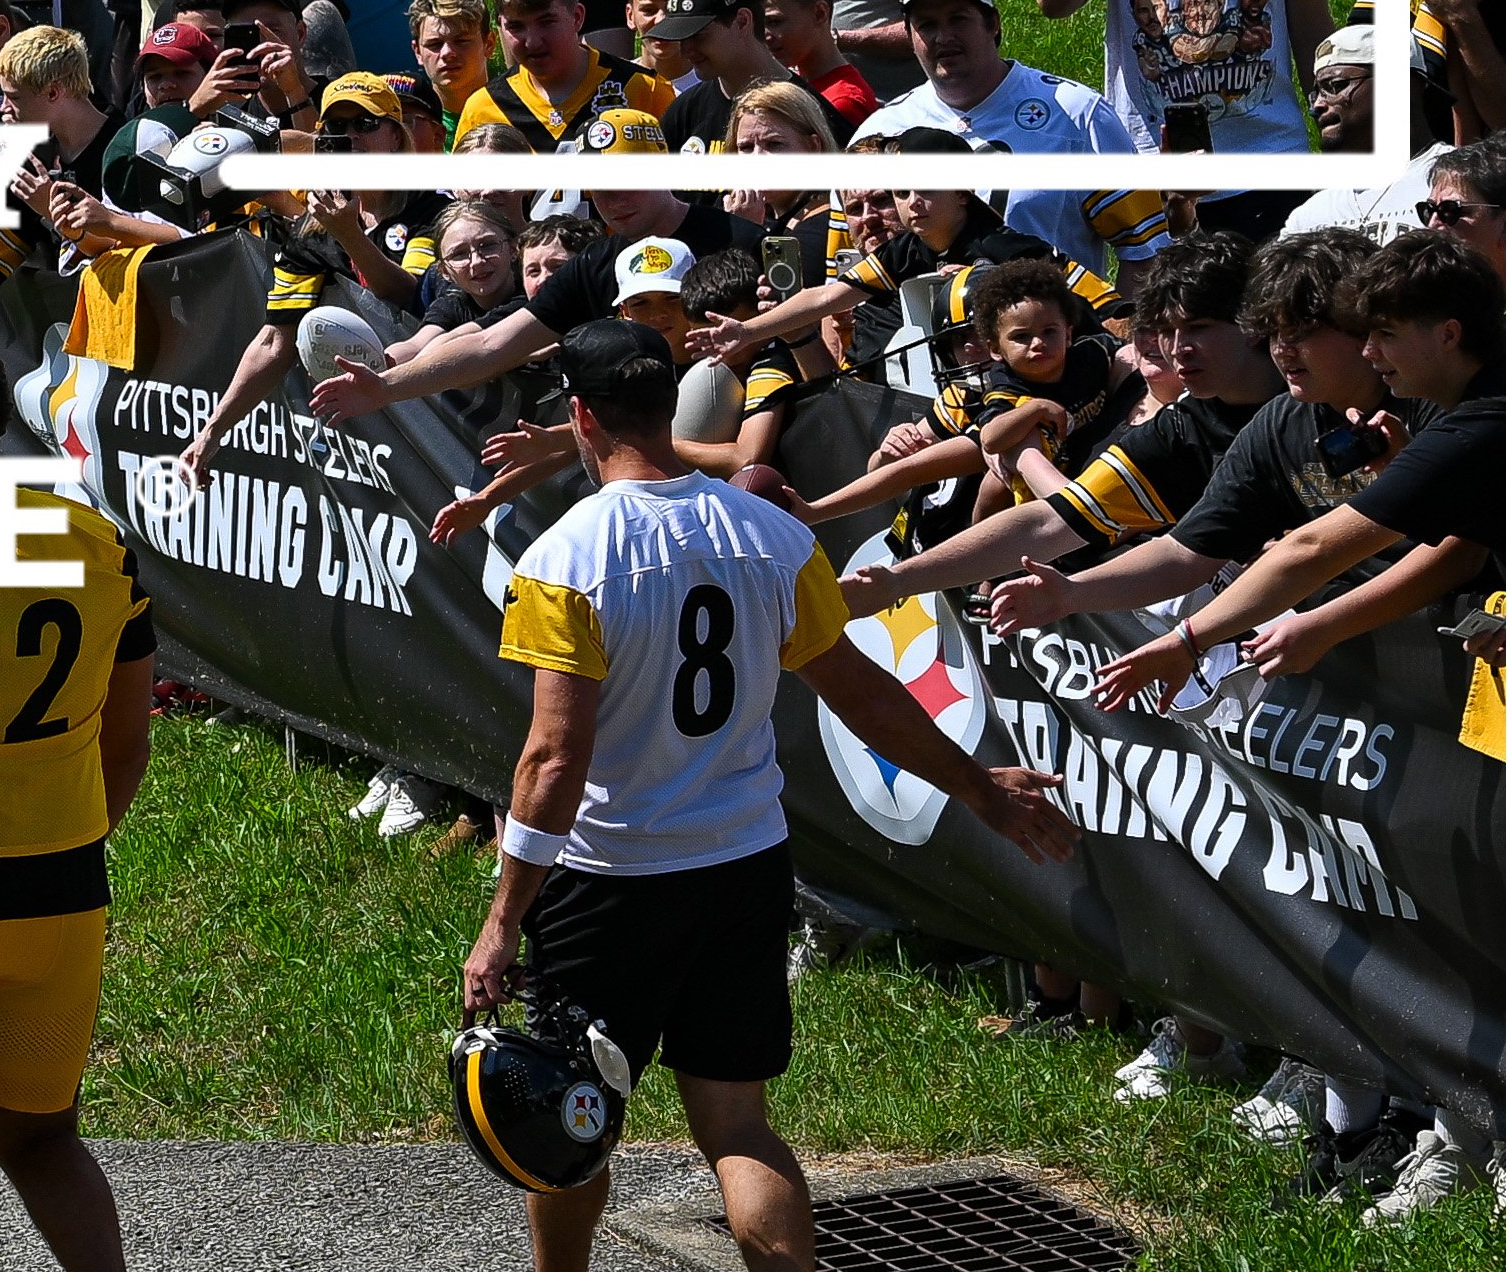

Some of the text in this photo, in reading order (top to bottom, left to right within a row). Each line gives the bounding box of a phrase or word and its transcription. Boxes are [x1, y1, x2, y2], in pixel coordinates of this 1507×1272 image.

[114, 379, 288, 458] PITTSBRGH
[118, 449, 418, 617] TRAINING CAMP
[672, 583, 737, 738] 8
[1252, 778, 1419, 921] CAM
